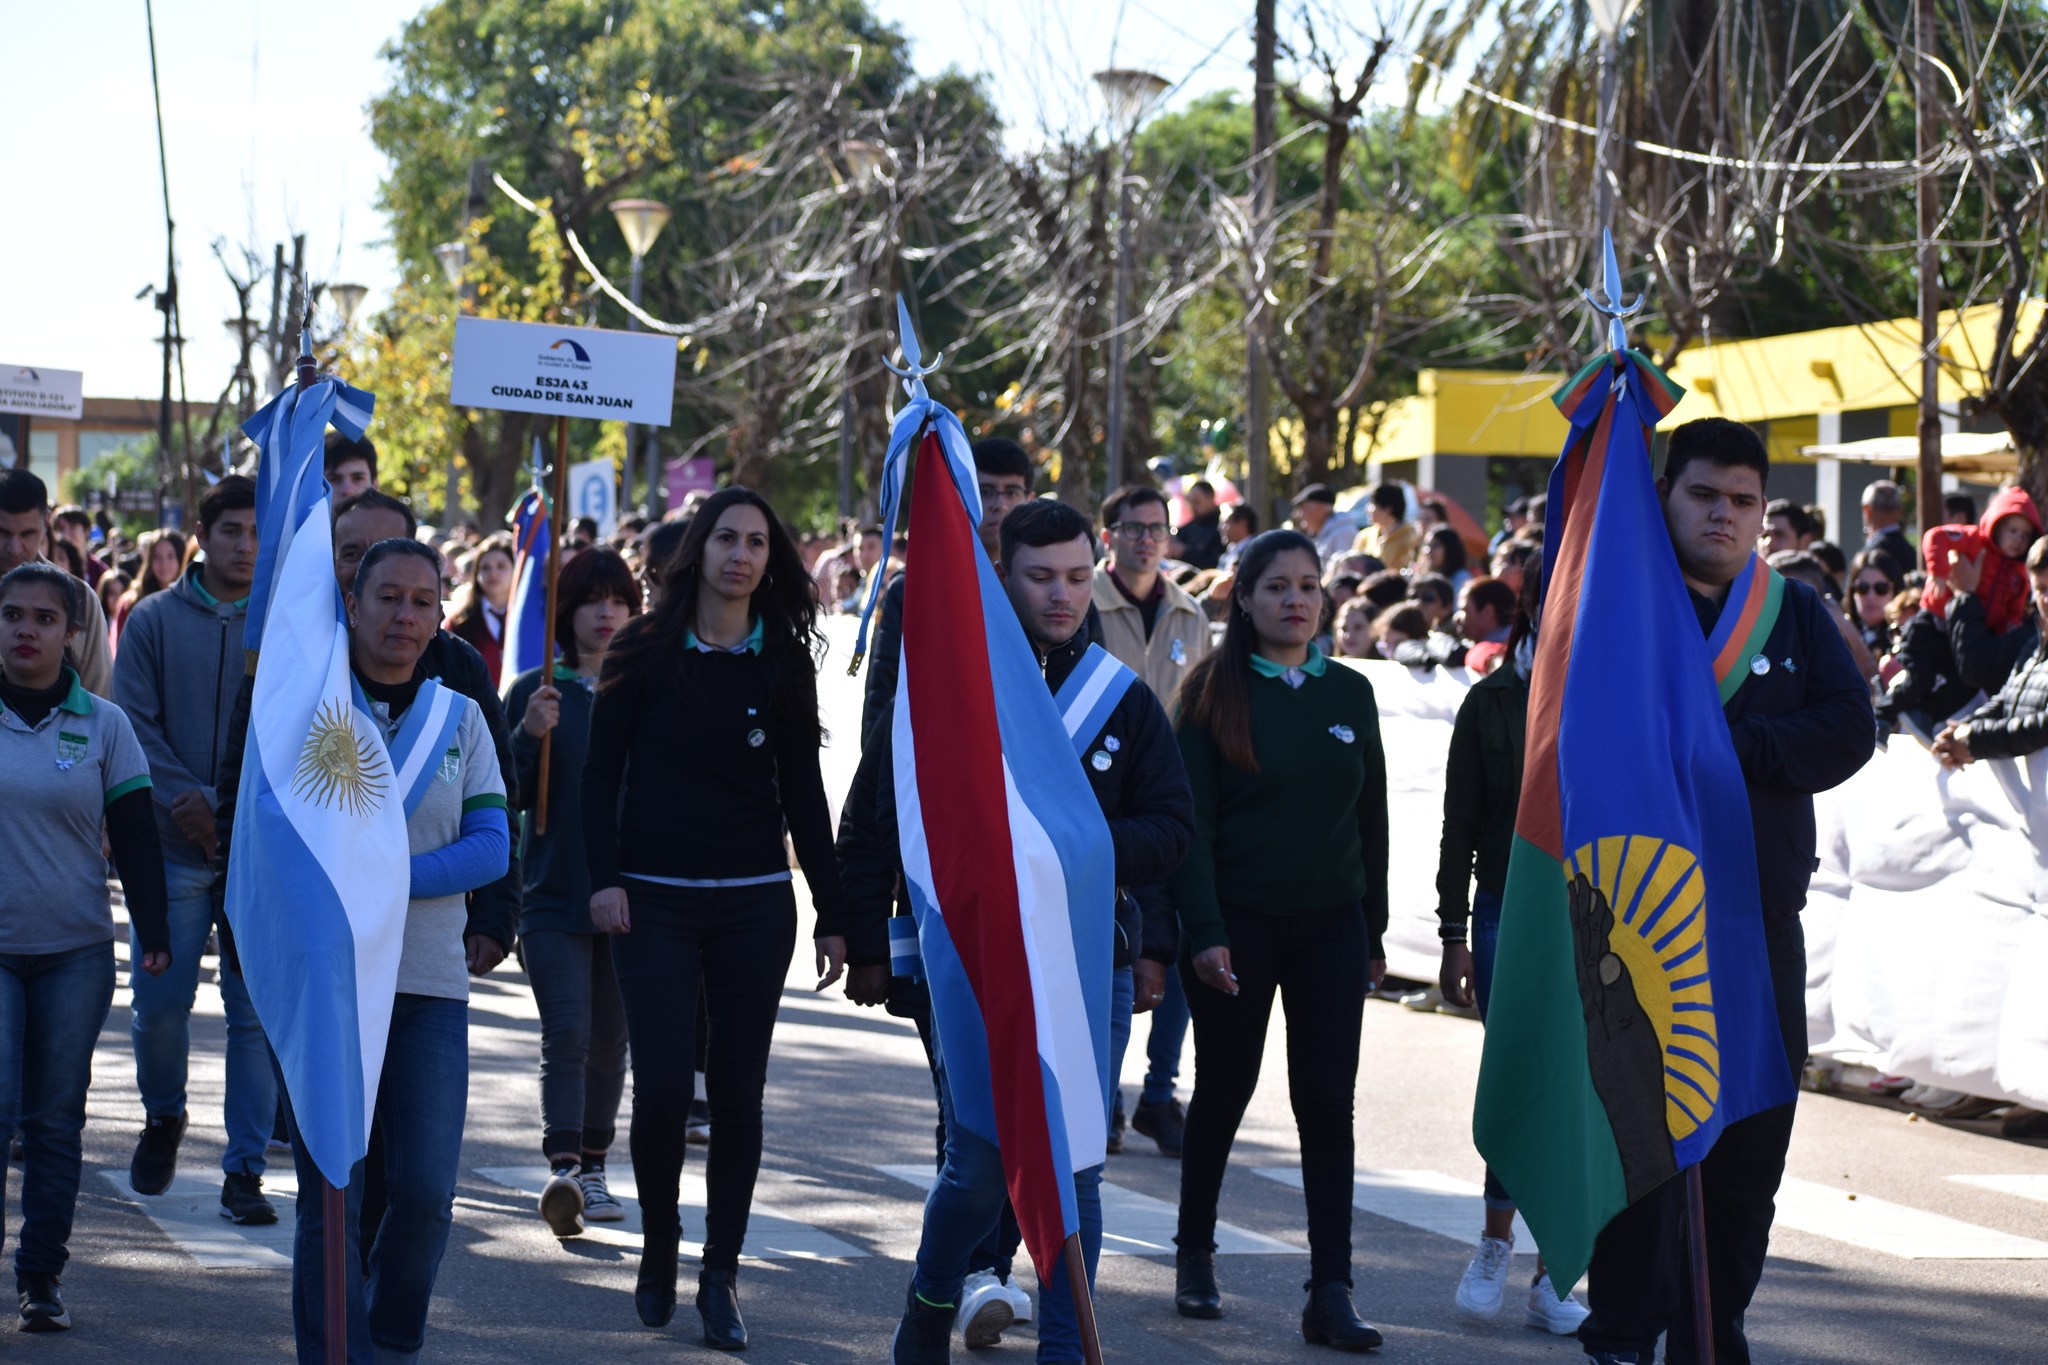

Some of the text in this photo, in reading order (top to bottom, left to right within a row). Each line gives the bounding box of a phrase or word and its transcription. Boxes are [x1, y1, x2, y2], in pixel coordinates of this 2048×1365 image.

[536, 376, 588, 391] ESJA 43
[491, 385, 633, 409] CIUDAD DE SAN JUAN
